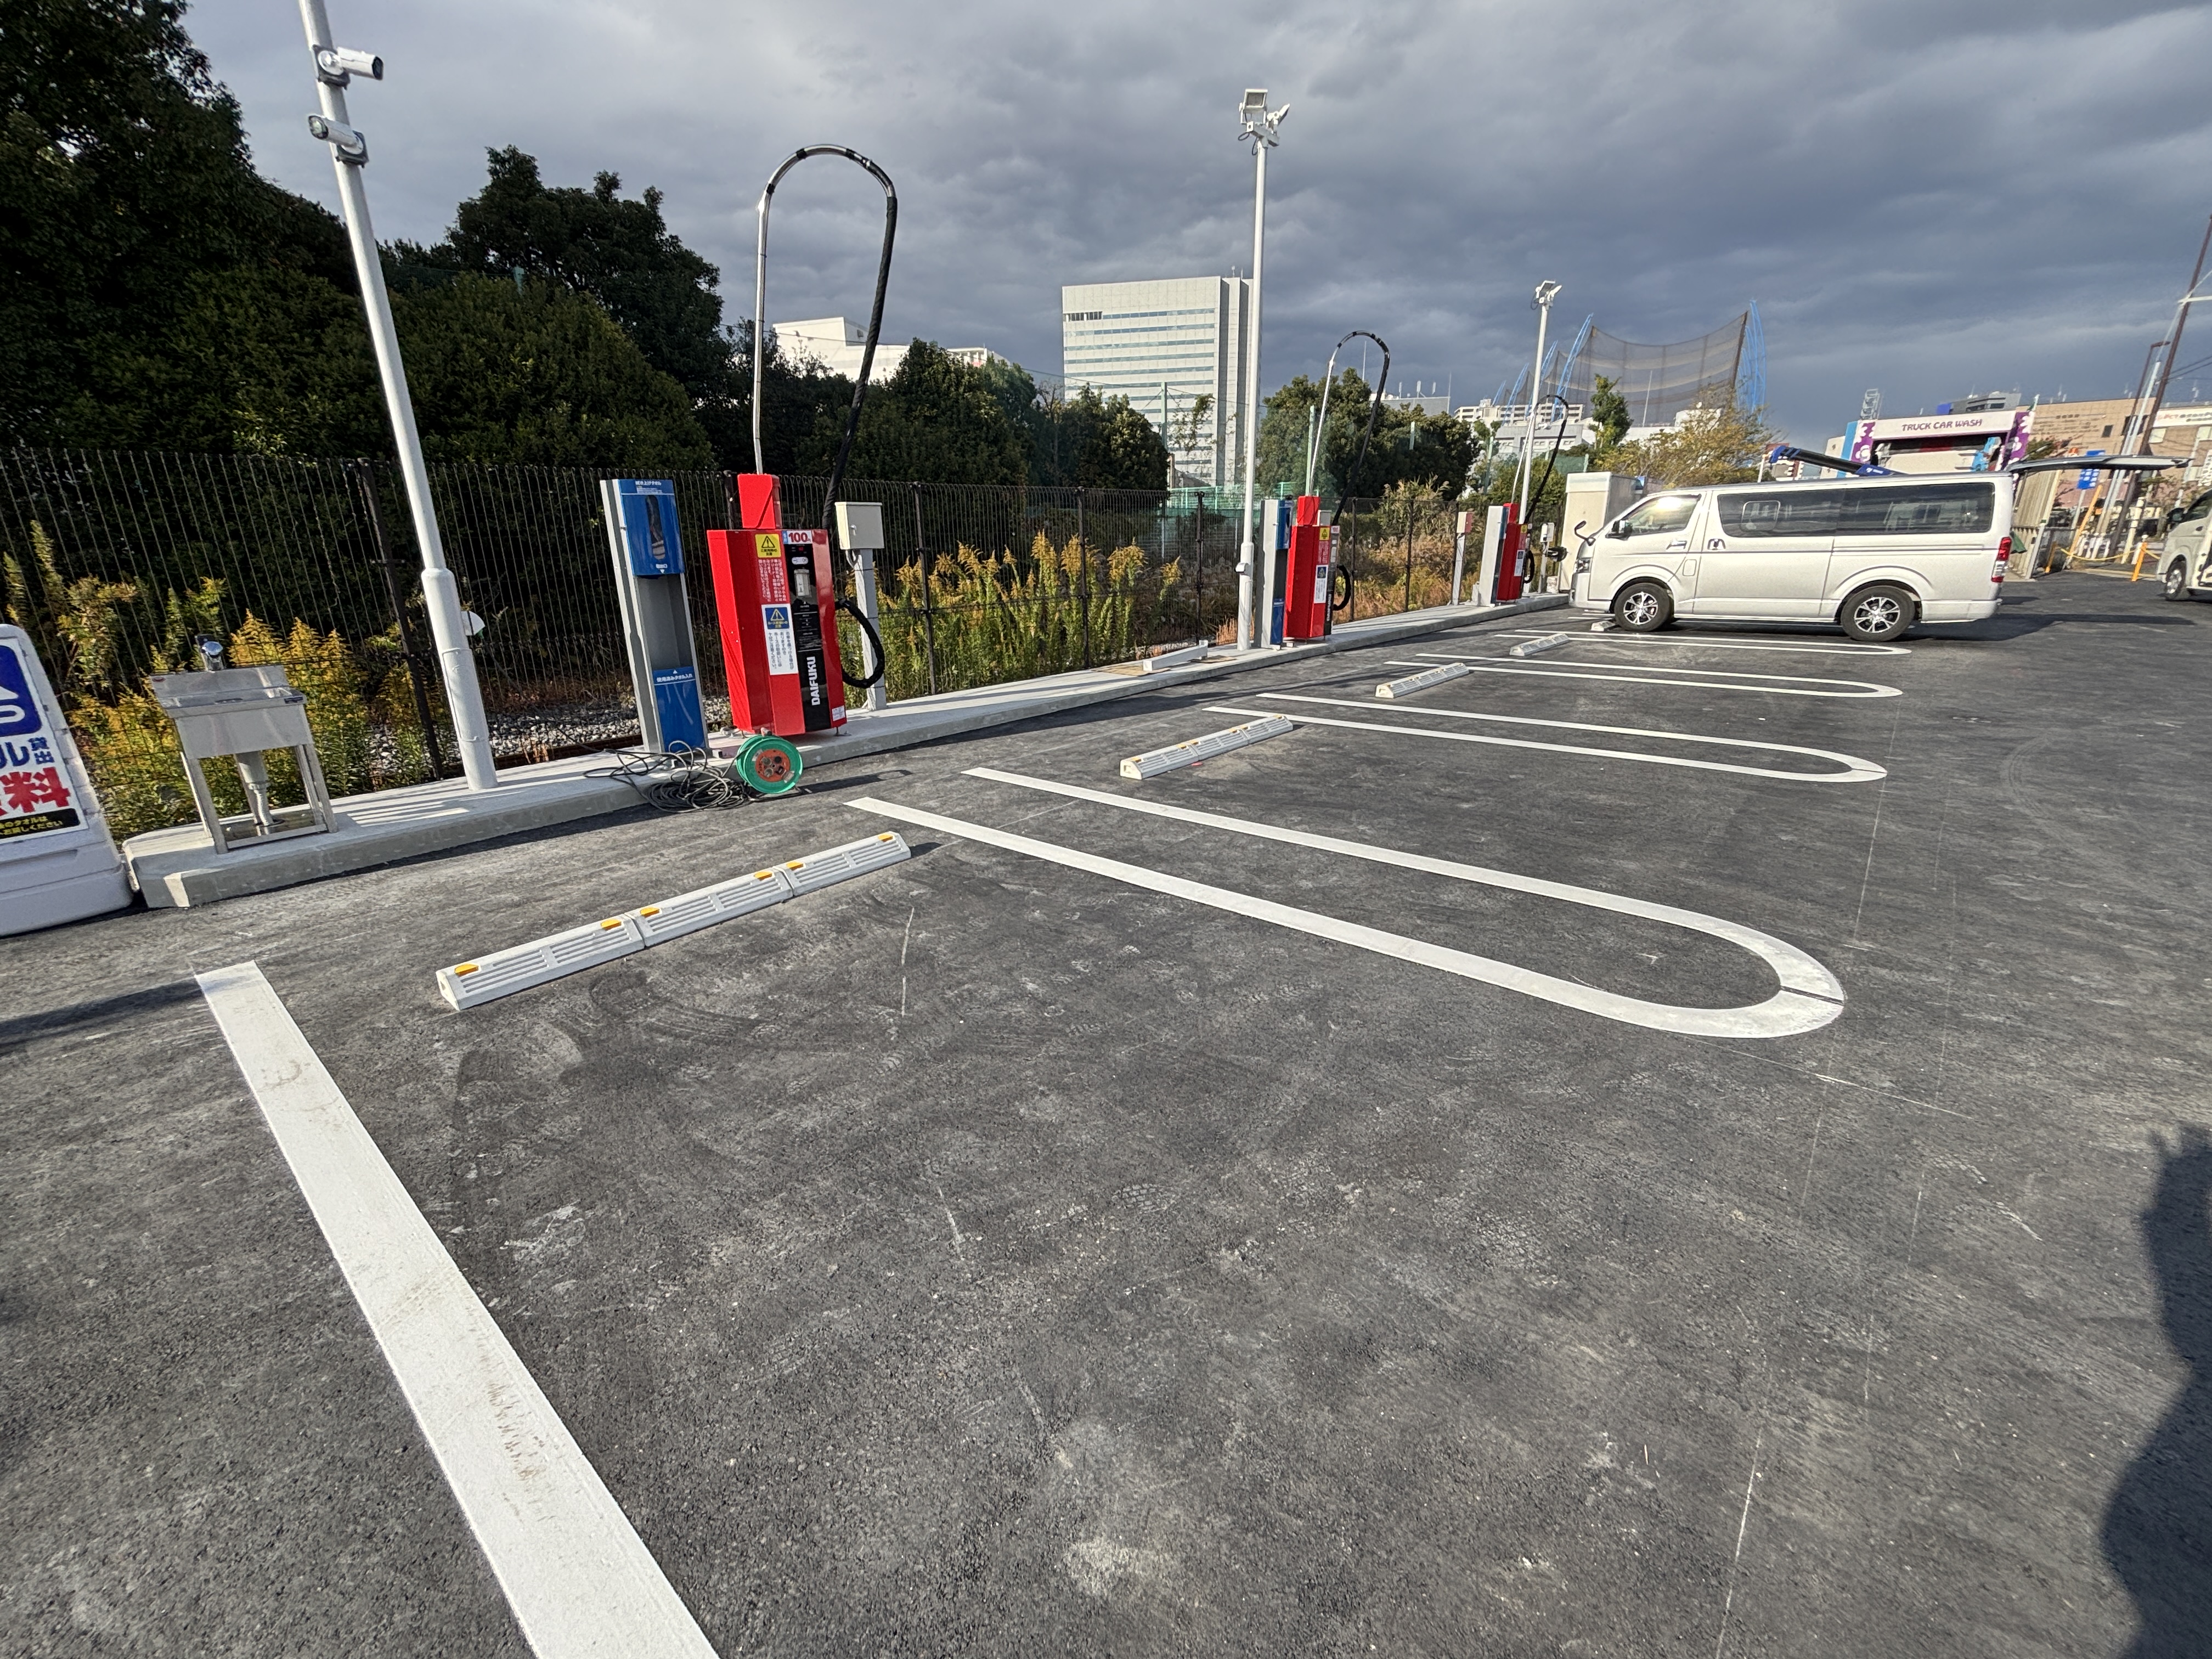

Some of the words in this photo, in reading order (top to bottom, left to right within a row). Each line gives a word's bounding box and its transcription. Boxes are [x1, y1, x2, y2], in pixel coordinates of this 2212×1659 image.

[1901, 422, 1932, 431] TRUCK
[1933, 421, 1954, 429] CAR
[1955, 419, 1983, 427] WASH
[806, 656, 821, 706] DAIFUKU
[0, 766, 71, 817] 料
